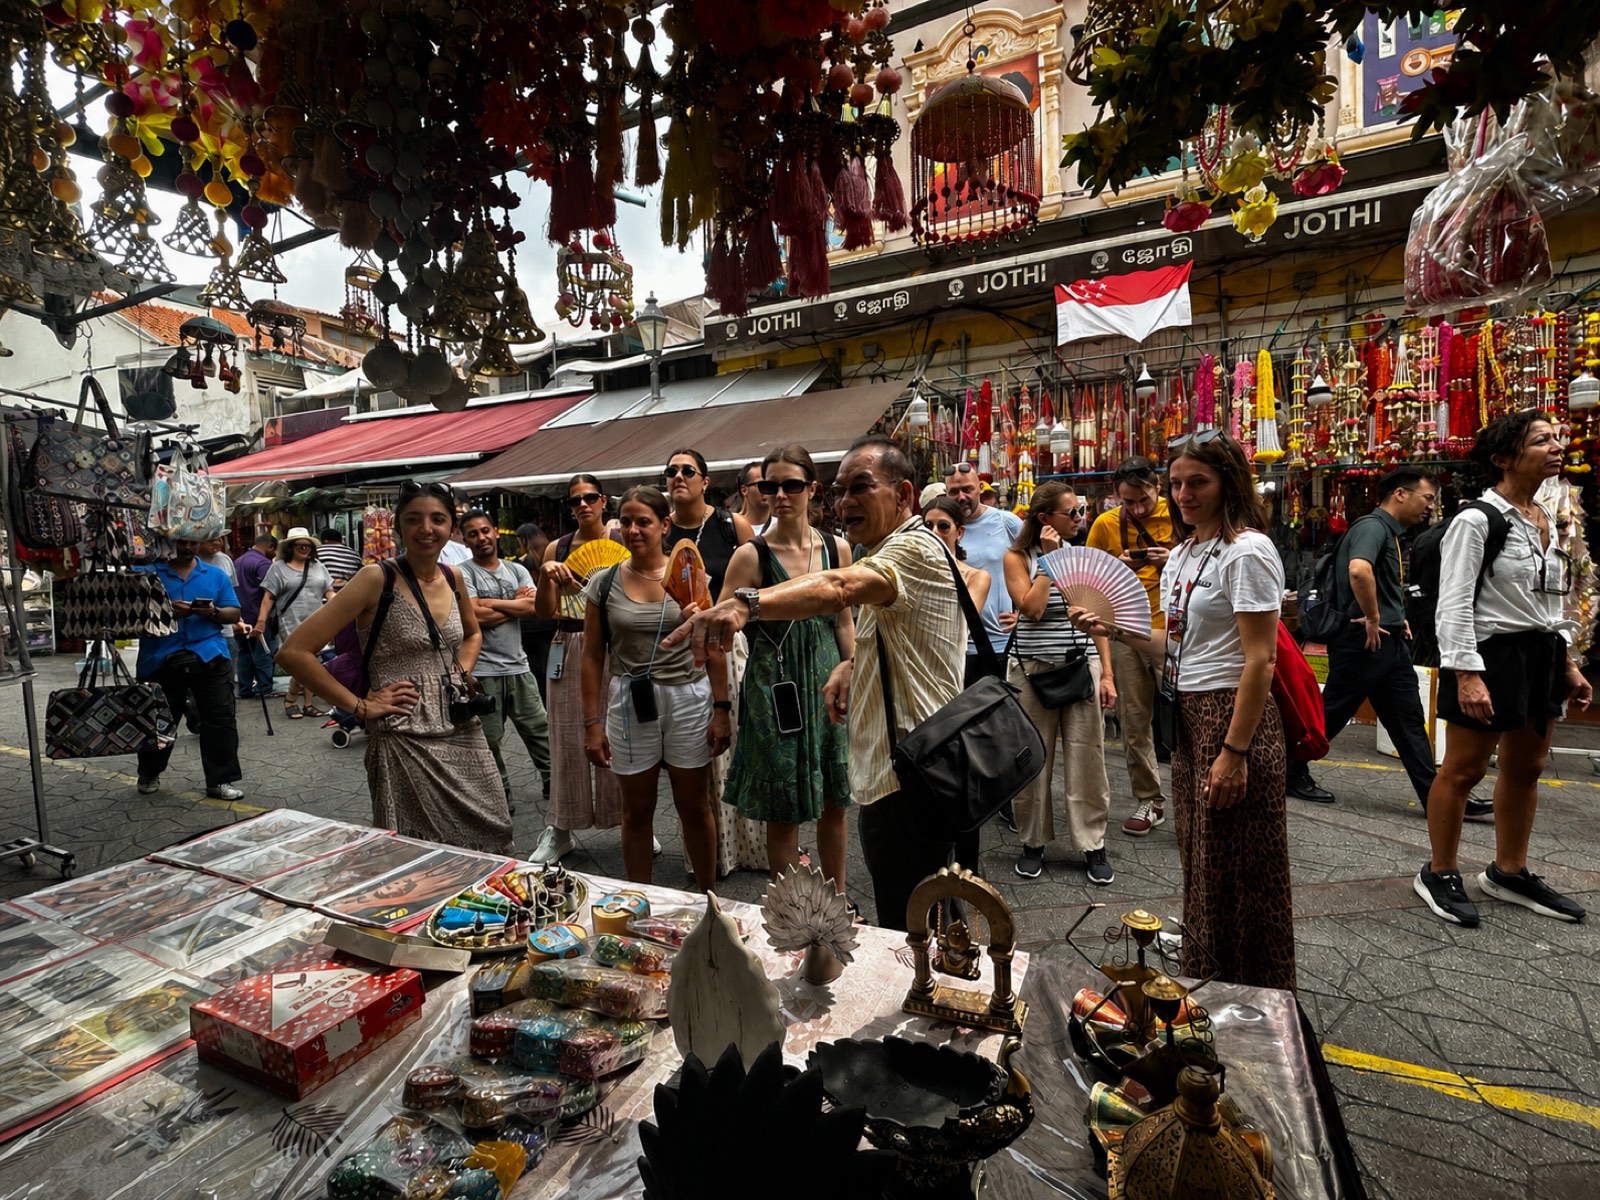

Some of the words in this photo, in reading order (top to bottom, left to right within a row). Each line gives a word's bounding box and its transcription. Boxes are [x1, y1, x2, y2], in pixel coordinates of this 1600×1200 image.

[1284, 200, 1381, 240] JOTHI
[1122, 237, 1192, 265] ஜோதி
[977, 264, 1046, 294] JOTHI
[855, 290, 910, 315] ஜோதி
[748, 312, 800, 336] JOTHI
